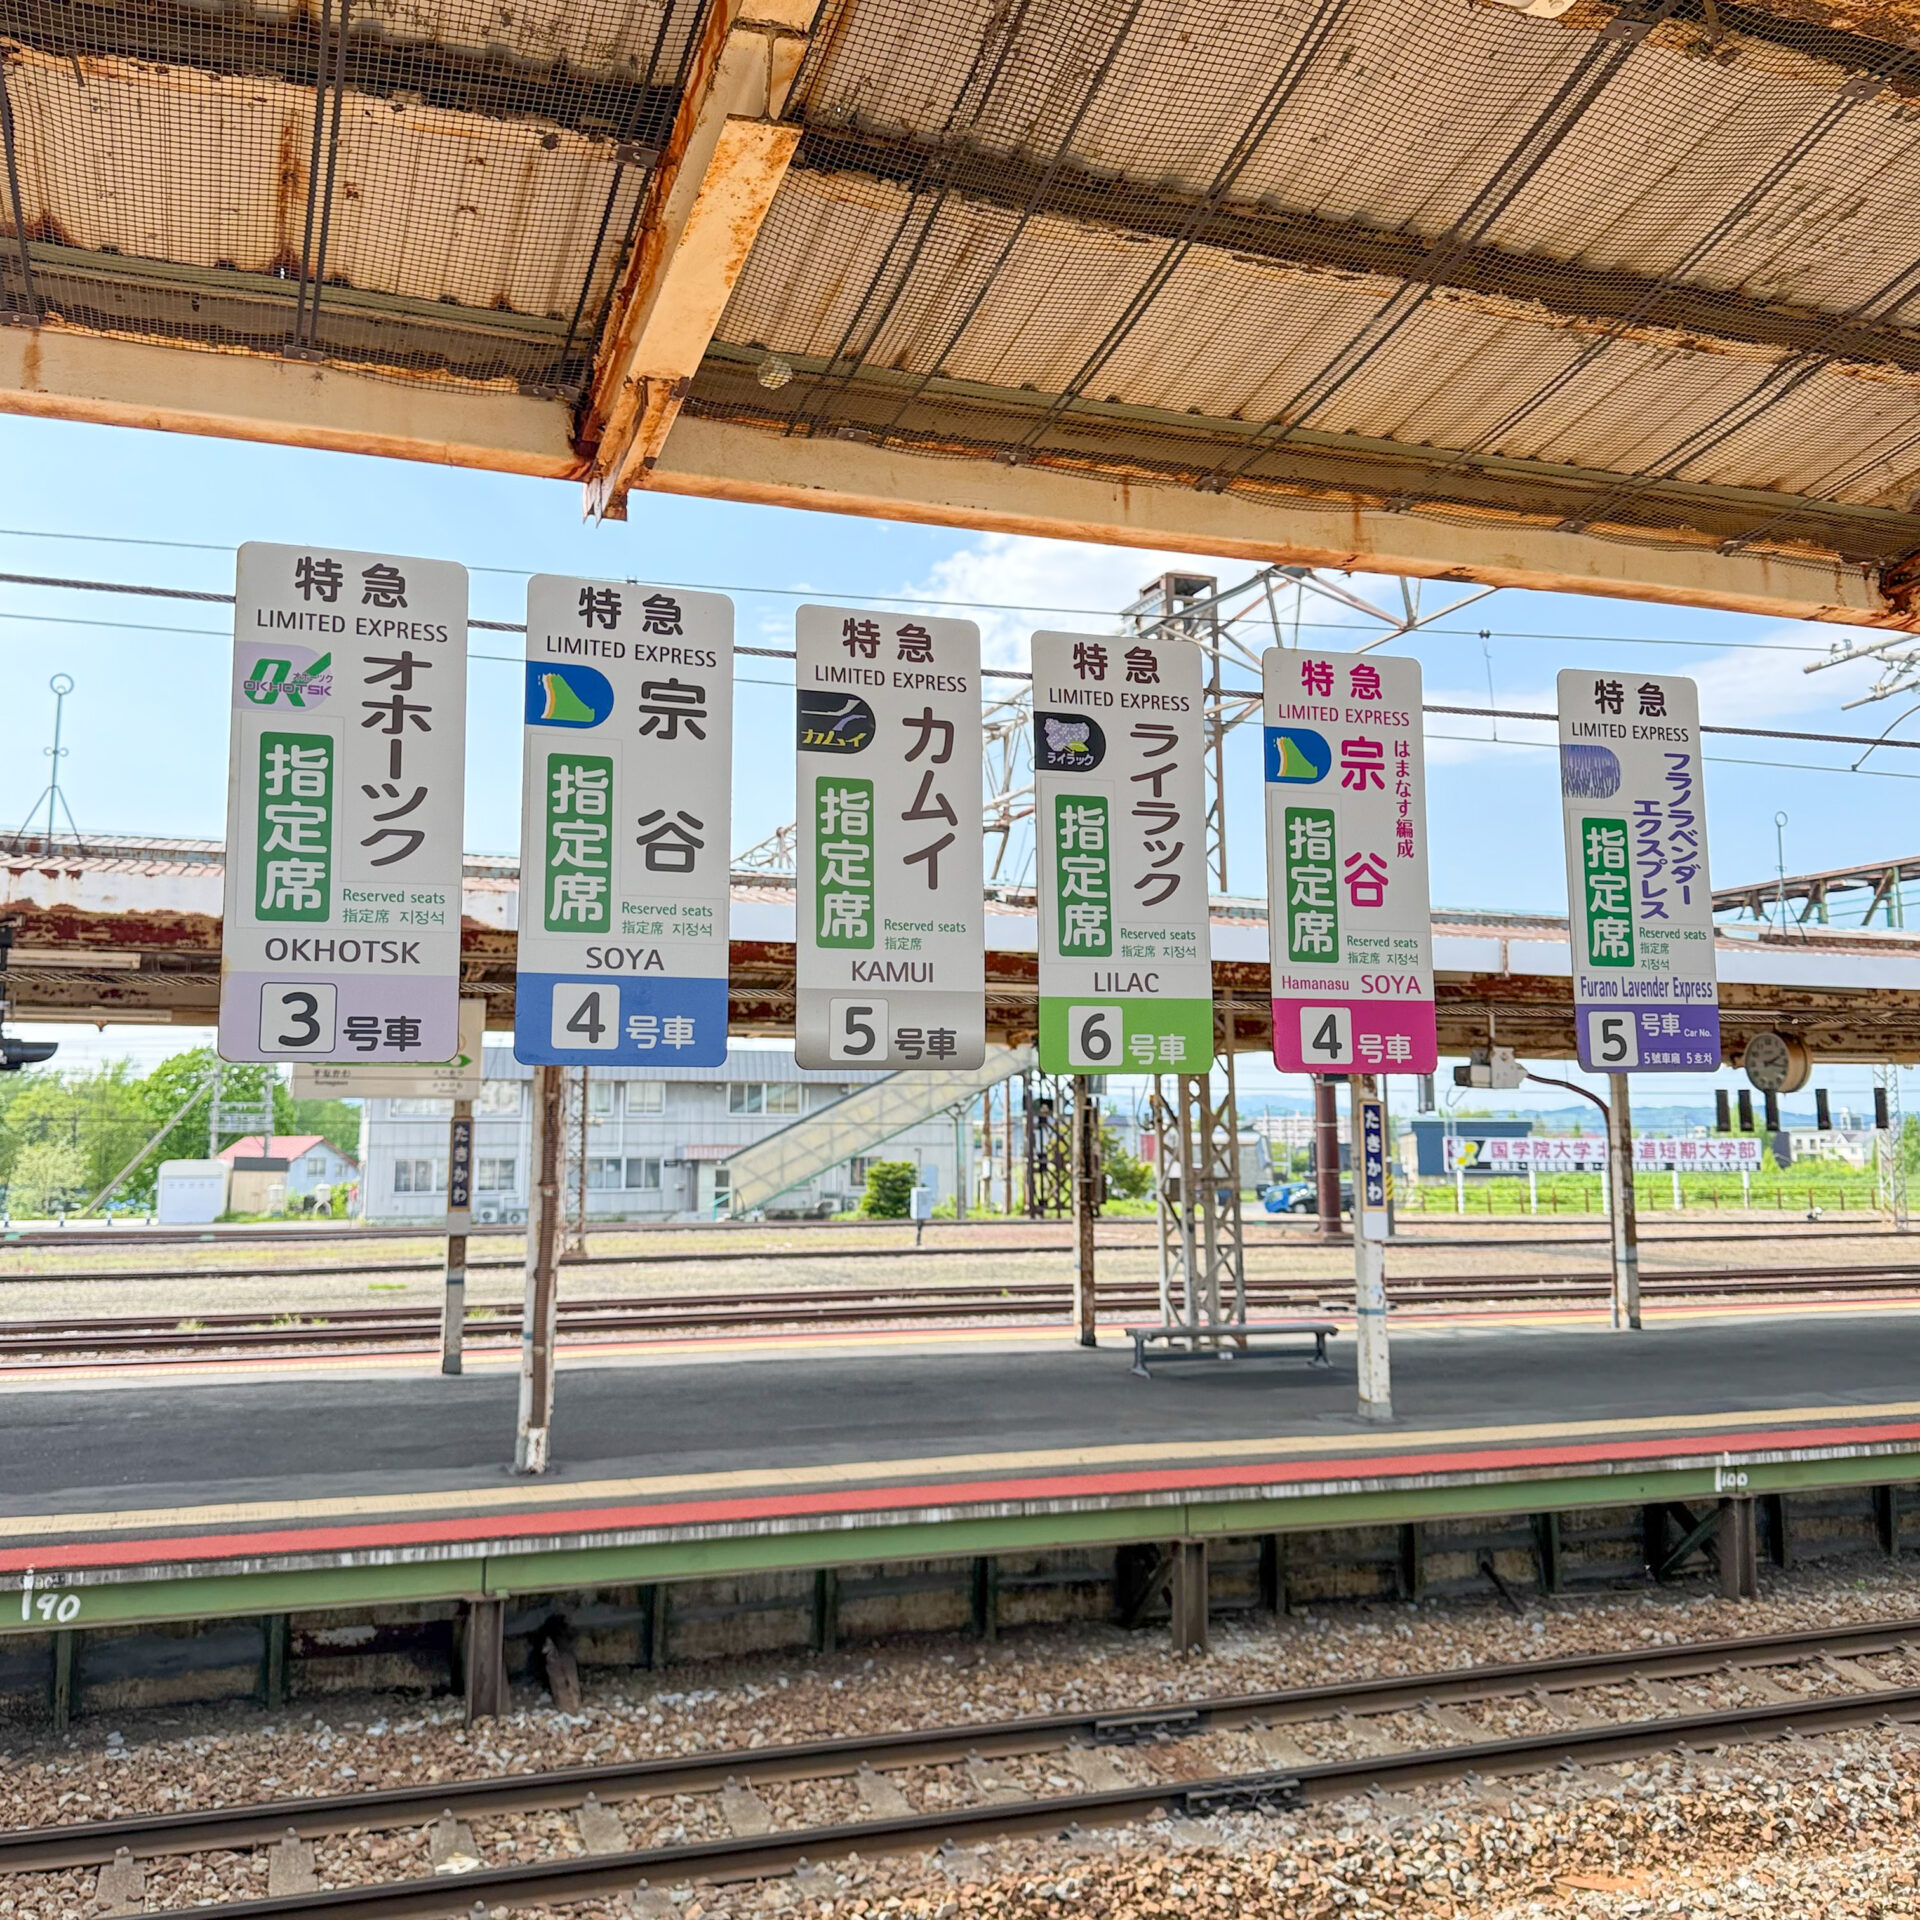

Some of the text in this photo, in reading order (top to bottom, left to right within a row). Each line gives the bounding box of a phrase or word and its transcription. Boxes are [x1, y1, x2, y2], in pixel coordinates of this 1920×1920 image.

[295, 556, 408, 608] 特急
[578, 586, 683, 635] 特急
[257, 609, 448, 642] LIMITED EXPRESS
[547, 635, 717, 668] LIMITED EXPRESS
[842, 617, 934, 663] 特急
[1073, 642, 1160, 684] 特急
[243, 680, 332, 696] OKHOTSK
[815, 665, 967, 693] LIMITED EXPRESS
[1301, 659, 1383, 700] 特急
[1049, 687, 1190, 712] LIMITED EXPRESS
[1594, 679, 1667, 717] 特急
[1278, 703, 1410, 727] LIMITED EXPRESS
[801, 728, 867, 748] カムイ
[1572, 721, 1689, 743] LIMITED EXPRESS
[361, 651, 433, 867] オホーツク
[1047, 752, 1094, 766] ライラック
[636, 678, 707, 873] 宗谷
[901, 706, 958, 890] カムイ
[1394, 740, 1414, 858] はまなす編成
[261, 743, 329, 911] 指定席
[1130, 723, 1184, 907] ライラック
[1340, 736, 1389, 908] 宗谷
[1664, 752, 1701, 905] フラノラベンダー
[550, 765, 609, 922] 指定席
[820, 787, 871, 939] 指定席
[1633, 800, 1669, 920] エクスプレス
[1059, 804, 1108, 948] 指定席
[1289, 816, 1335, 954] 指定席
[343, 888, 445, 904] Reserved seats
[1586, 826, 1630, 958] 指定席
[342, 908, 390, 924] 指定席
[400, 910, 445, 925] 지정석
[622, 902, 713, 917] Reserved seats
[622, 920, 664, 935] 指定席
[672, 922, 713, 937] 지정석
[884, 918, 966, 933] Reserved seats
[1120, 928, 1196, 941] Reserved seats
[1639, 926, 1707, 941] Reserved seats
[265, 937, 420, 964] OKHOTSK
[884, 936, 922, 950] 指定席
[1121, 945, 1156, 958] 指定席
[1162, 946, 1197, 959] 지정석
[1346, 935, 1418, 949] Reserved seats
[1640, 941, 1670, 955] 指定席
[586, 946, 664, 971] SOYA
[852, 960, 934, 983] KAMUI
[1347, 952, 1380, 965] 指定席
[1386, 953, 1419, 966] 지정석
[1640, 958, 1670, 971] 지정석
[1094, 972, 1160, 993] LILAC
[1281, 974, 1422, 995] Hamanasu SOYA
[1580, 975, 1713, 1003] Furano Lavender Express
[278, 991, 422, 1052] 3 号車
[566, 991, 696, 1050] 4 号車
[843, 1006, 957, 1060] 5 号車
[1683, 1028, 1698, 1037] Car
[1081, 1012, 1187, 1066] 6 号車
[1312, 1013, 1413, 1064] 4 号車
[1601, 1012, 1681, 1062] 5 号車
[453, 1125, 469, 1203] たきかわ
[1365, 1109, 1382, 1202] たきかわ
[1490, 1141, 1756, 1160] 国学院大学道短期大学部
